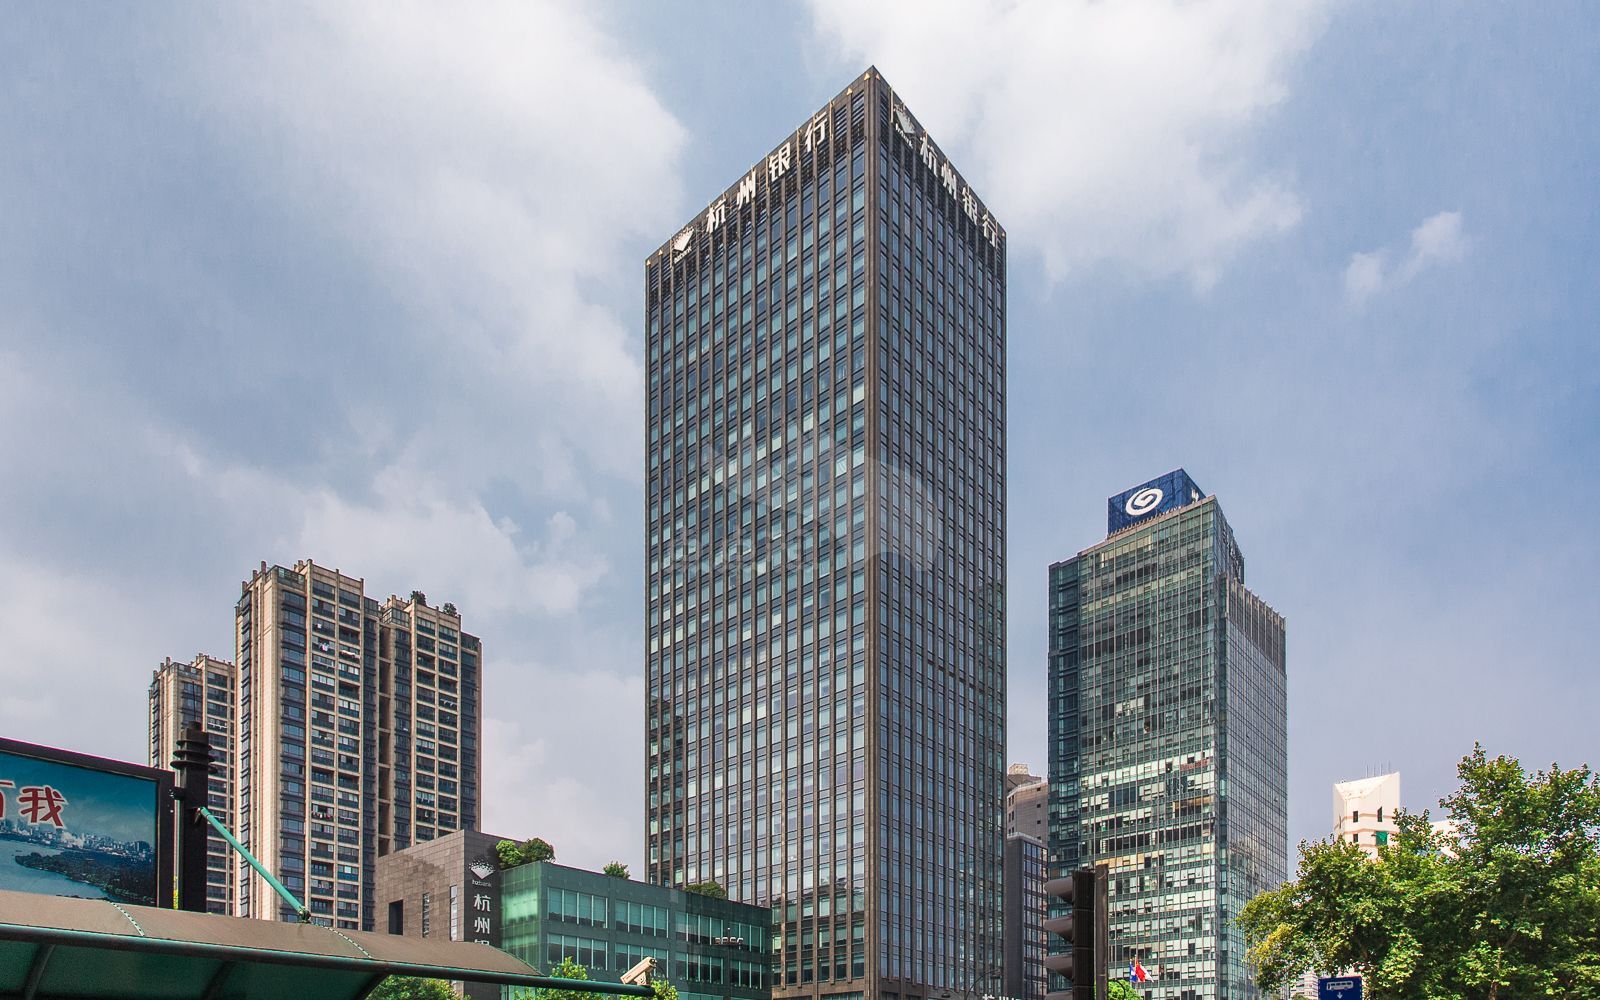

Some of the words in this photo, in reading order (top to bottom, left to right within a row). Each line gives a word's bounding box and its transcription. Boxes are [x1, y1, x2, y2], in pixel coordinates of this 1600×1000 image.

[706, 111, 828, 235] 杭州银行
[920, 137, 998, 248] 杭州银行
